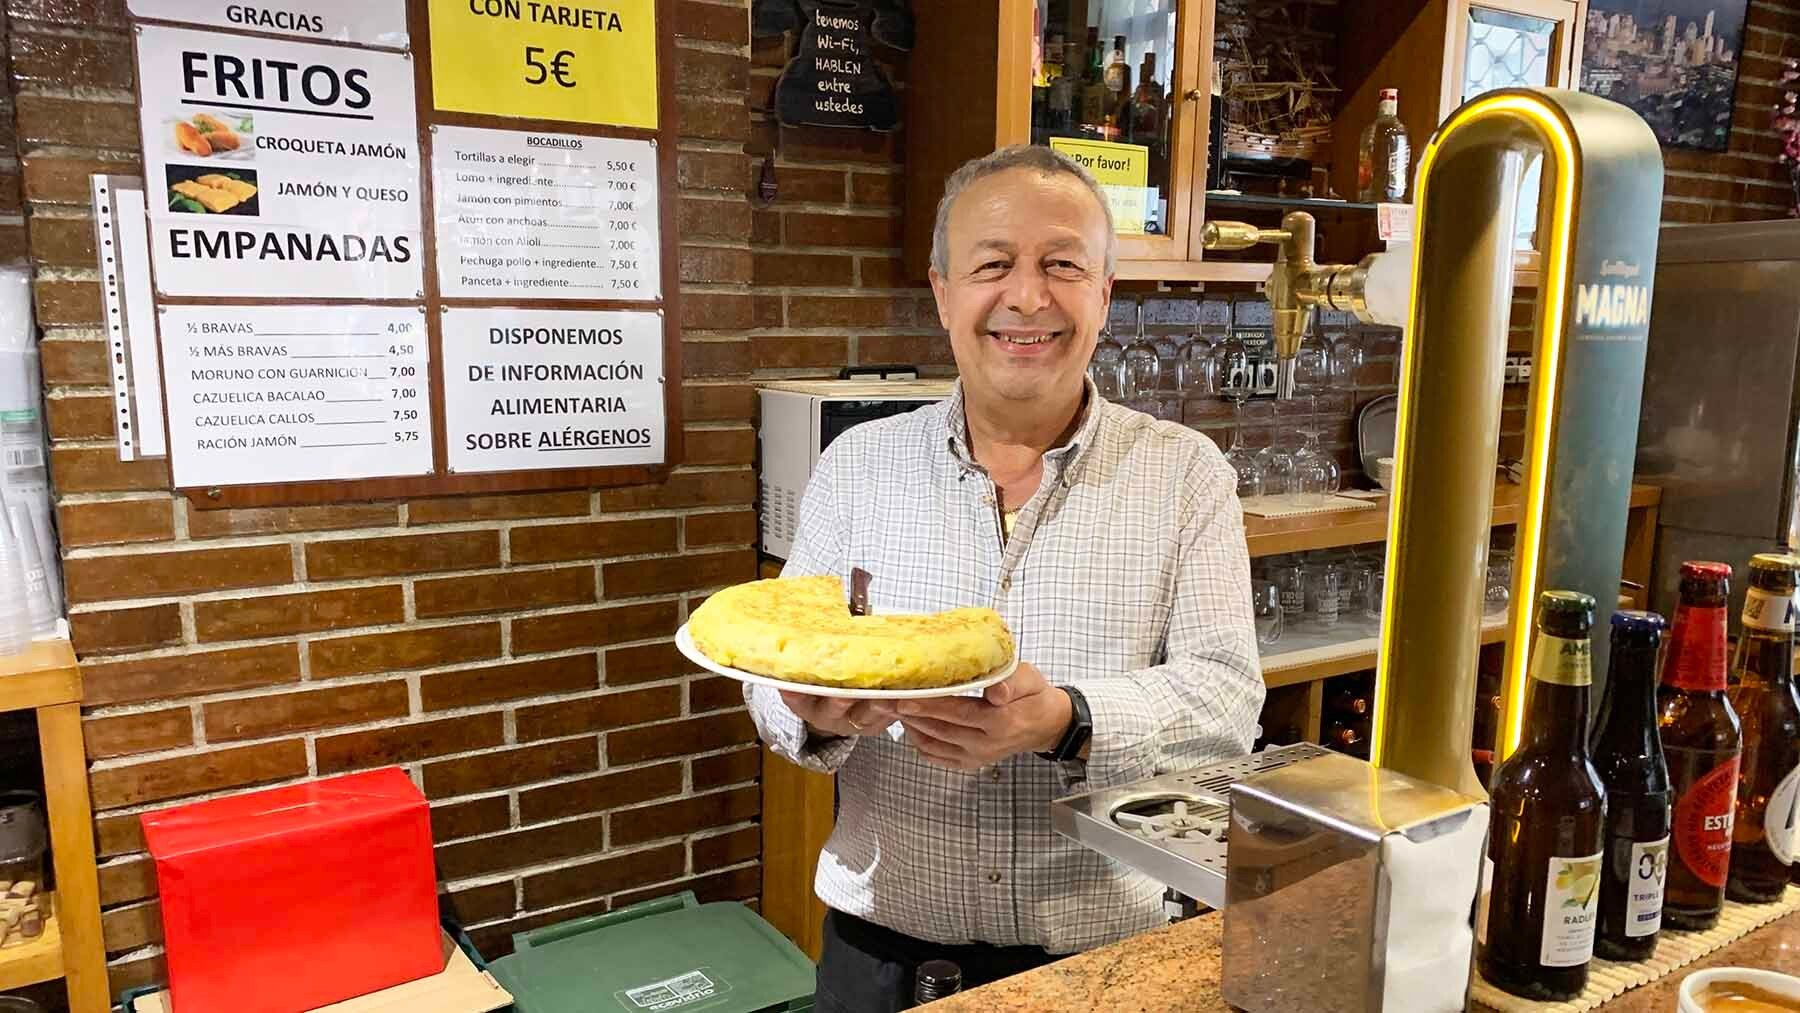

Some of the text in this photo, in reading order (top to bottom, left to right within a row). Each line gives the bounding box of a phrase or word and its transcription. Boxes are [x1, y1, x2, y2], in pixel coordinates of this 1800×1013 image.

[226, 5, 323, 33] GRACIAS
[469, 0, 623, 32] CON TARJETA
[816, 9, 859, 30] tenemos
[817, 35, 859, 55] Wi-Fi,
[524, 46, 577, 88] 5€
[815, 57, 861, 75] HABLEN
[181, 50, 372, 111] FRITOS
[817, 77, 851, 93] entre
[815, 96, 863, 114] ustedes
[255, 135, 406, 160] CROQUETA JAMÓN
[526, 135, 583, 149] BOCADILLOS
[454, 151, 496, 163] Tortillas
[508, 155, 535, 167] elegir
[607, 161, 627, 171] 5,50
[630, 162, 635, 171] €
[1097, 155, 1131, 172] favor!
[456, 172, 485, 182] Lomo
[630, 182, 636, 191] €
[277, 181, 409, 202] JAMÓN Y QUESO
[493, 196, 511, 204] con
[515, 196, 561, 207] pimientos
[486, 216, 504, 225] con
[507, 217, 548, 227] anchoas
[609, 221, 629, 231] 7,00
[169, 228, 411, 264] EMPANADAS
[460, 256, 503, 268] Pechuga
[506, 257, 531, 268] pollo
[542, 258, 596, 270] ingrediente
[610, 260, 630, 270] 7,50
[461, 276, 502, 287] Panceta
[514, 278, 568, 288] ingrediente
[611, 280, 631, 289] 7,50
[634, 280, 639, 289] €
[1575, 284, 1647, 326] MAGNA
[201, 322, 254, 335] BRAVAS
[489, 328, 623, 345] DISPONEMOS
[203, 343, 234, 358] MÁS
[237, 346, 288, 358] BRAVAS
[388, 345, 414, 358] 4,50
[191, 368, 254, 382] MORUNO
[258, 368, 286, 380] CON
[389, 366, 416, 379] 7,00
[468, 360, 644, 382] DE INFORMACIÓN
[192, 388, 416, 404] CAZUELICA BACALAO 7,00
[491, 397, 626, 415] ALIMENTARIA
[195, 409, 418, 428] CAZUELICA CALLOS 7,50
[197, 431, 419, 451] RACIÓN JAMÓN 5,75
[466, 426, 651, 450] SOBRE ALÉRGENOS
